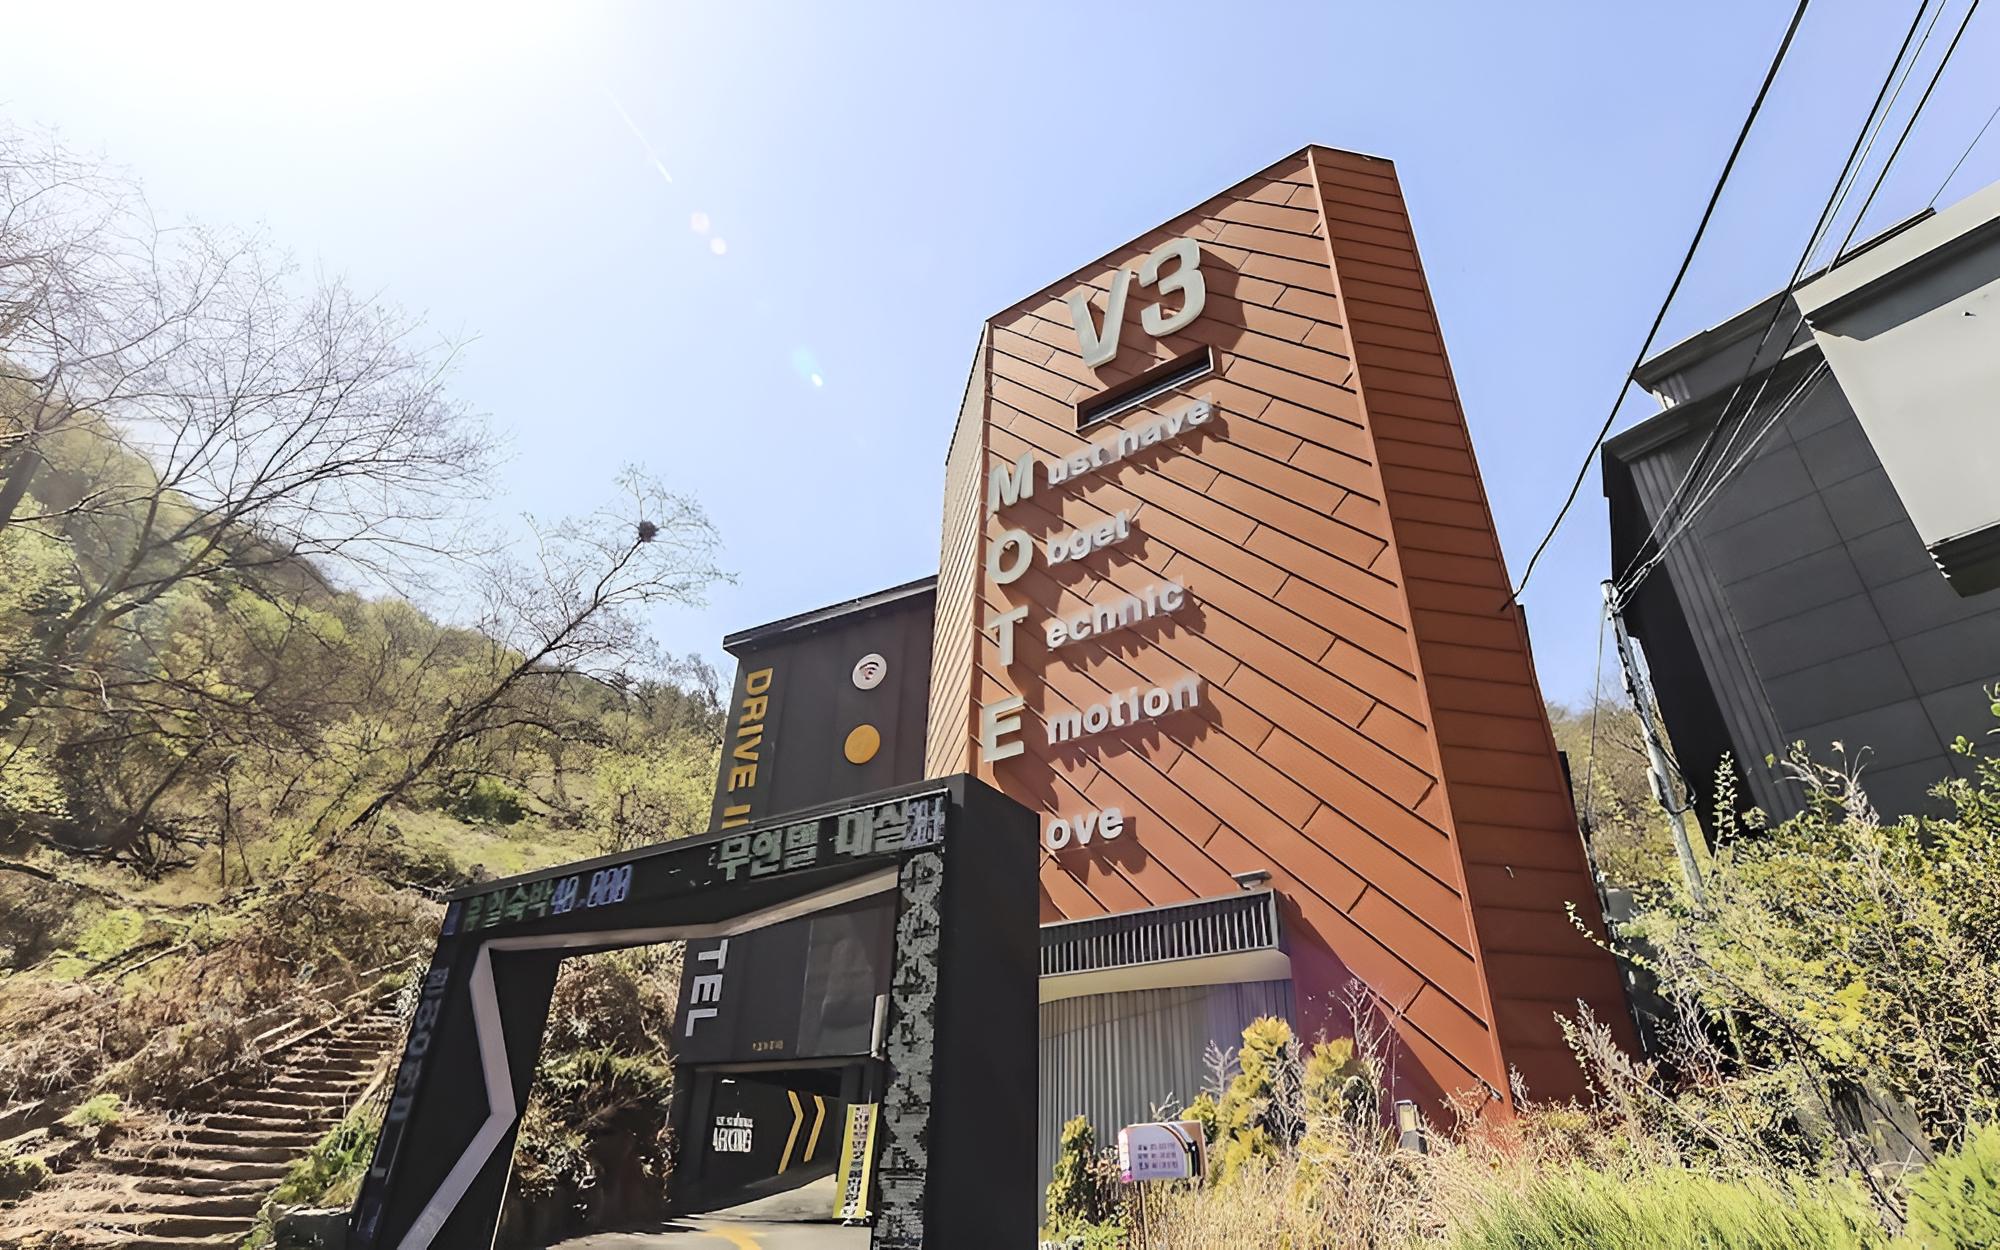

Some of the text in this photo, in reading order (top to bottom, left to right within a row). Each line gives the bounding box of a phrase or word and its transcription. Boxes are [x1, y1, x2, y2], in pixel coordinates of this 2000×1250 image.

[1067, 237, 1206, 369] V3
[728, 668, 774, 792] DRIVE
[1048, 676, 1201, 744] motion
[685, 939, 728, 1037] TEL
